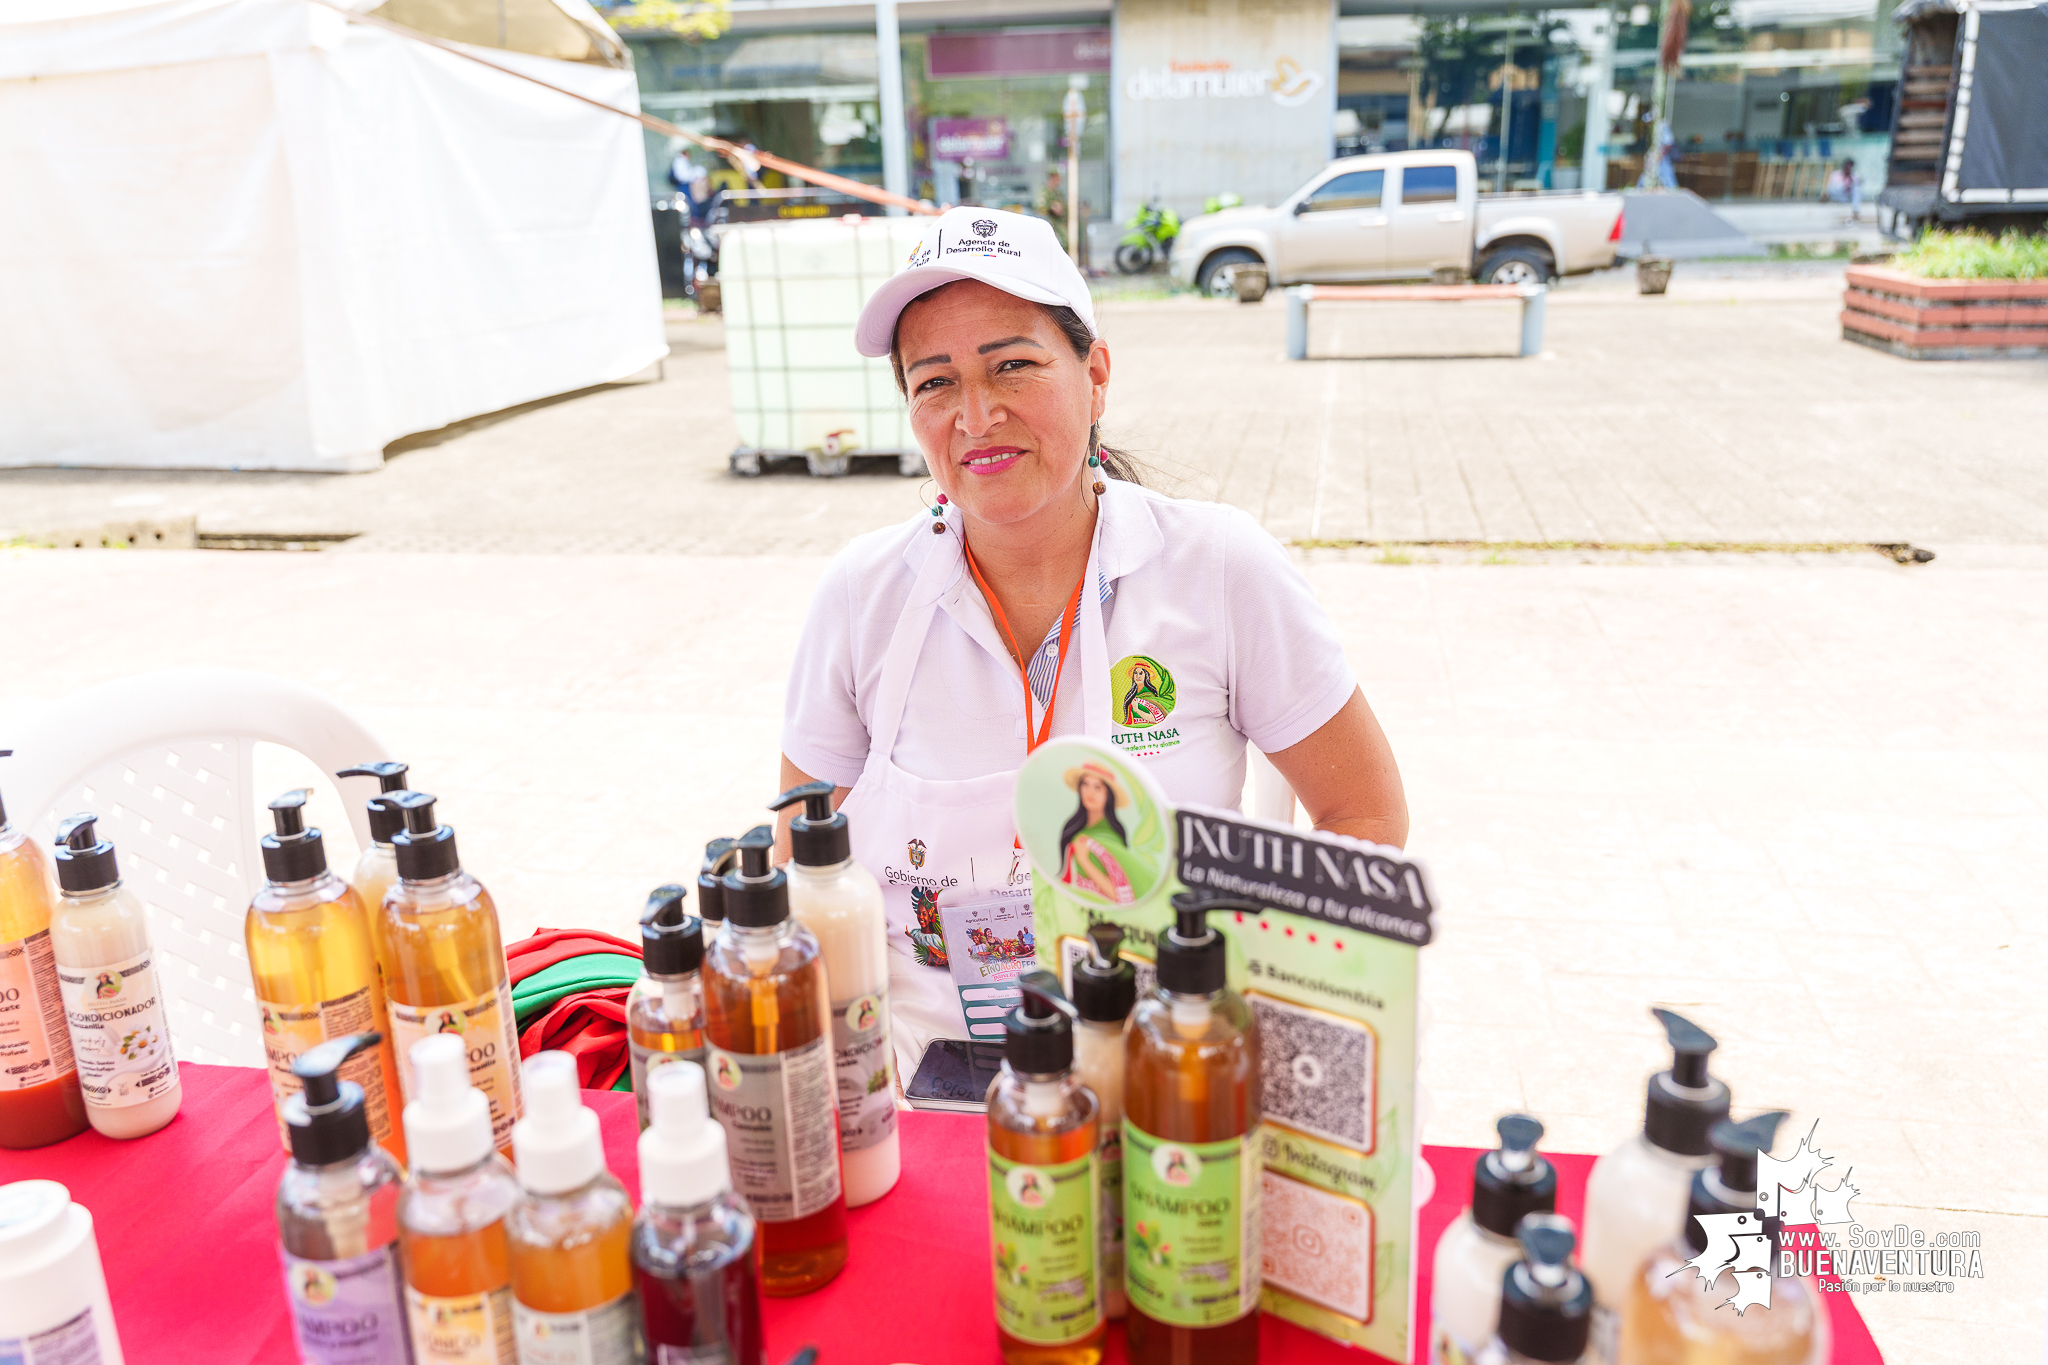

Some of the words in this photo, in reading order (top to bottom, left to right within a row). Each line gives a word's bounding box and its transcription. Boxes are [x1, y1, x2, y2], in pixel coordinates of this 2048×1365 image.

[946, 246, 993, 255] Desarrollo
[997, 247, 1021, 257] Rural
[958, 239, 996, 247] Agencia
[998, 240, 1010, 248] de
[1148, 728, 1180, 741] NASA
[885, 866, 937, 886] Gobierno
[940, 876, 959, 888] de
[1314, 846, 1426, 910] NASA
[1183, 861, 1205, 884] La
[1206, 867, 1307, 909] Naturaleza
[1307, 895, 1324, 913] a
[1324, 897, 1348, 920] tu
[1348, 904, 1427, 940] alcance
[1266, 965, 1384, 1010] Bancolombia
[1284, 1141, 1378, 1192] Instagram
